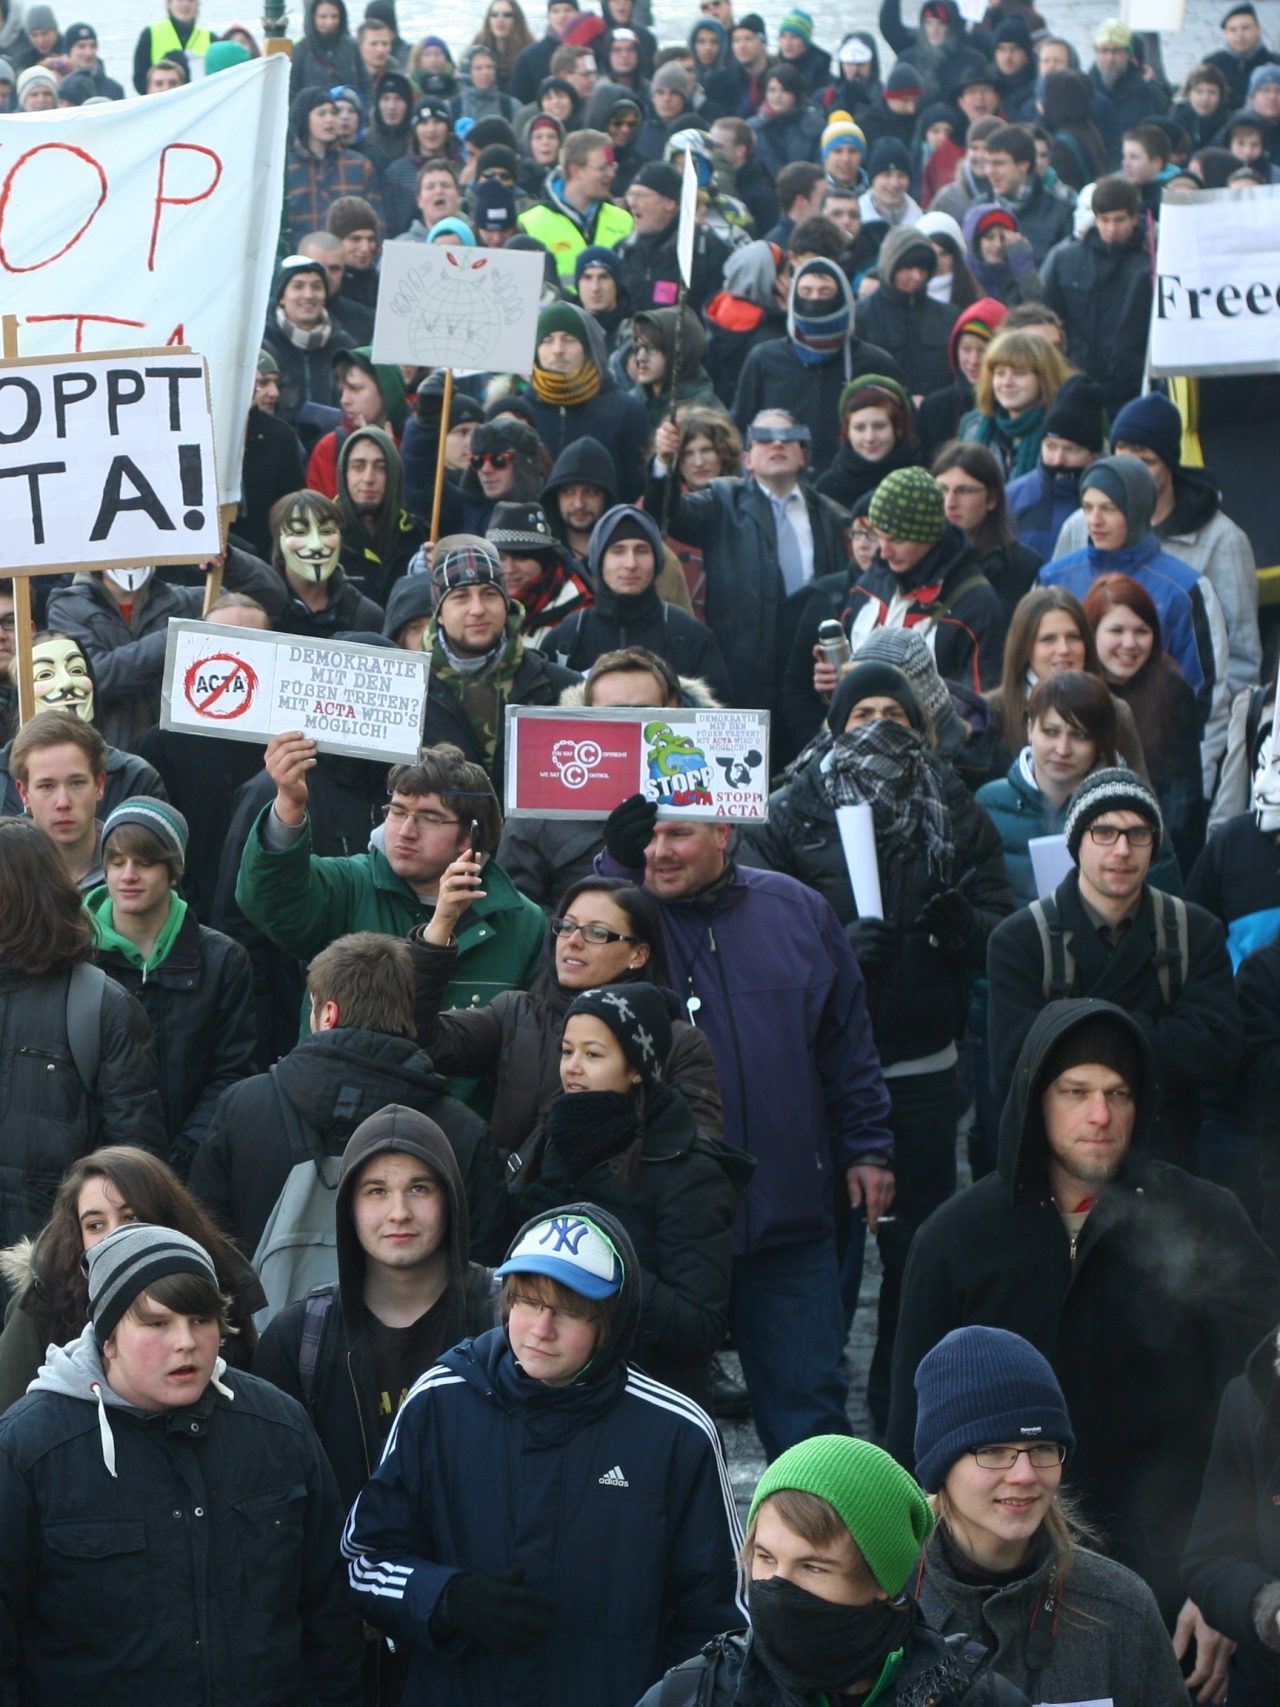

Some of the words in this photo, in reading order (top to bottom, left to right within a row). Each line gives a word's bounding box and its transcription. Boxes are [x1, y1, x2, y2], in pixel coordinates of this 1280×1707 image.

[1157, 274, 1280, 319] Free
[289, 646, 418, 679] DEMOKRATIE
[310, 666, 347, 686] MIT
[353, 672, 393, 693] DEN
[278, 695, 309, 712] MIT
[313, 700, 357, 719] ACTA
[361, 706, 419, 728] WIRD'S
[343, 688, 420, 712] TRETEN?
[304, 714, 388, 739] MÖGLICH!
[644, 765, 715, 800] STOPP
[715, 804, 760, 816] ACTA
[598, 1477, 629, 1487] adidas
